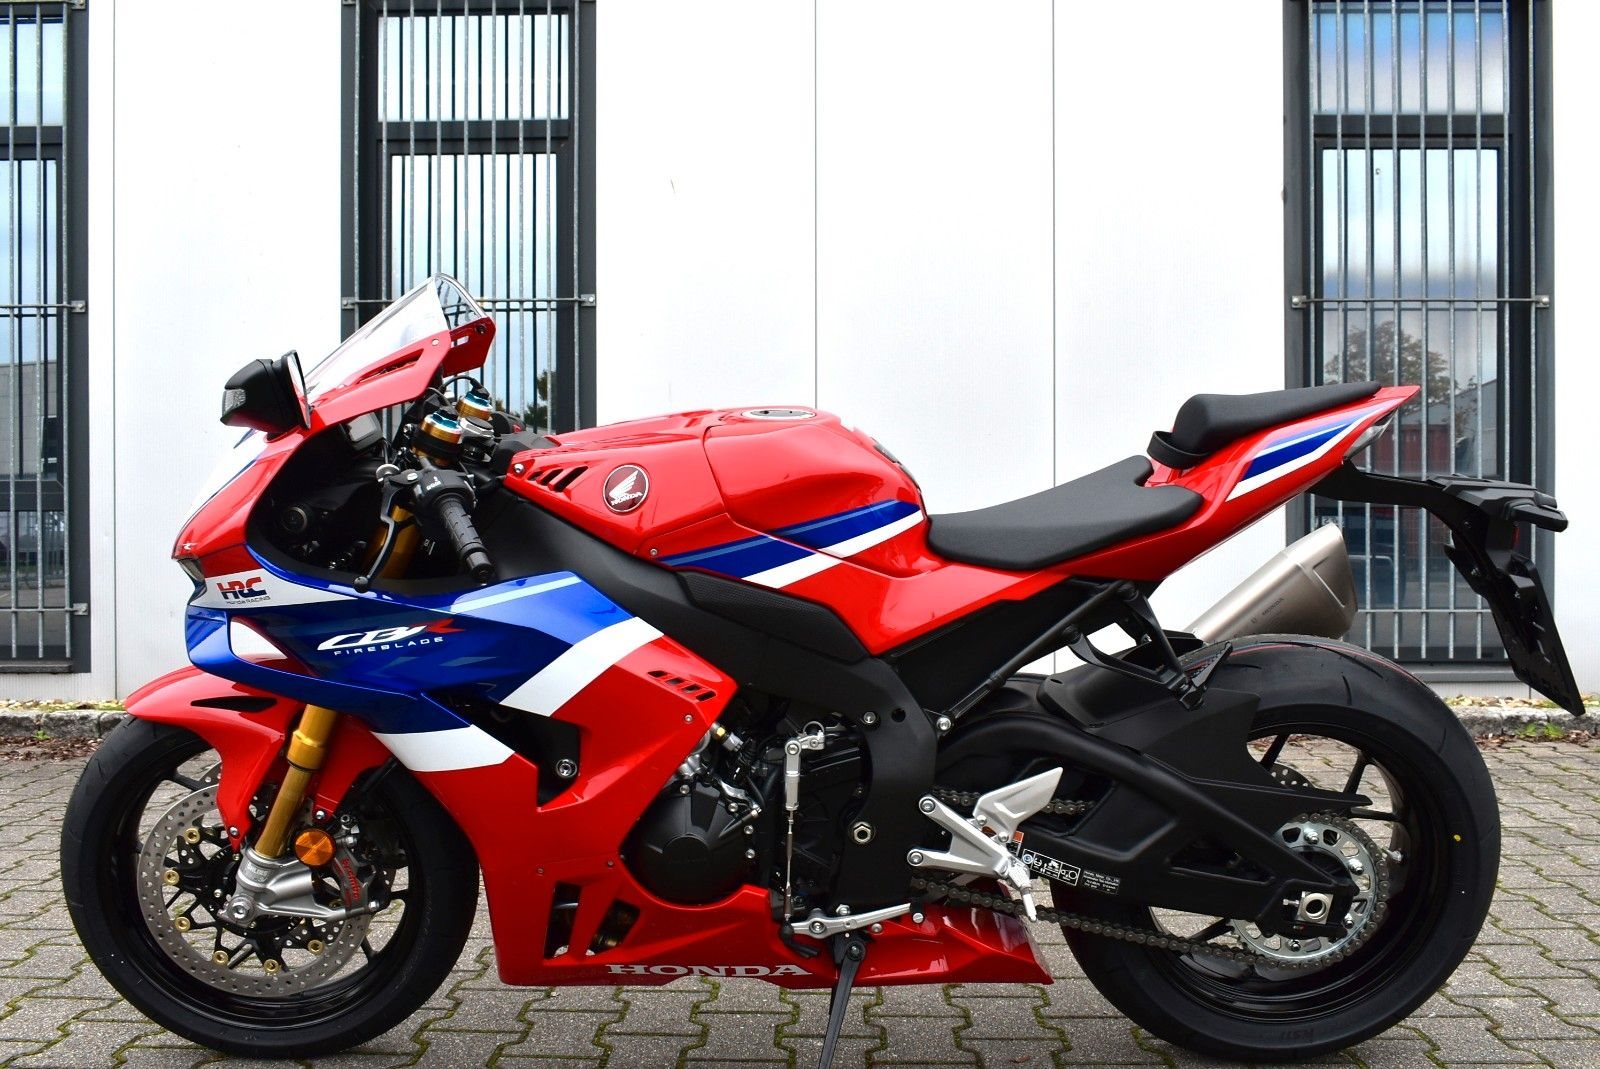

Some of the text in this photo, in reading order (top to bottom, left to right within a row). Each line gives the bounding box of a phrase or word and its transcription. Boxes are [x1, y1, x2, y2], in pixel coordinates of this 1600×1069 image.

[610, 491, 644, 506] HONDA
[216, 576, 267, 600] HRC
[333, 636, 444, 656] FIREBLADE
[605, 964, 813, 977] HONDA
